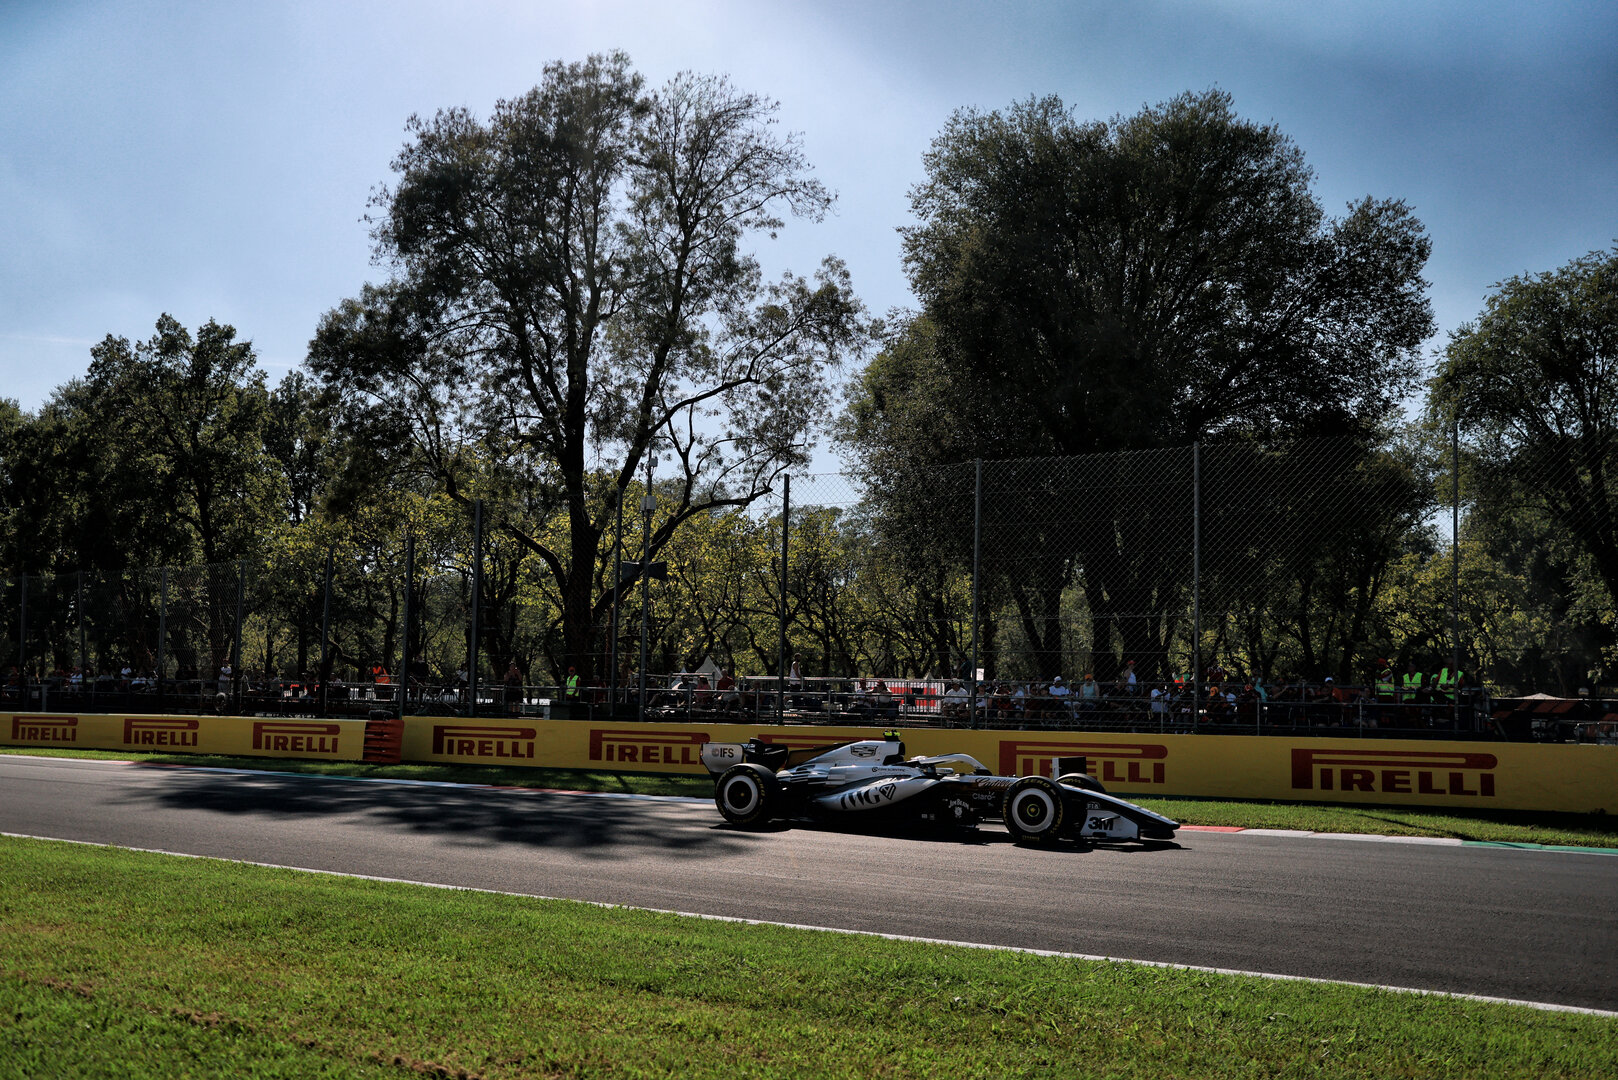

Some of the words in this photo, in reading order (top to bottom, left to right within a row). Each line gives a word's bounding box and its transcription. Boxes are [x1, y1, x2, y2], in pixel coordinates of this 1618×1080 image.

[12, 716, 78, 742] PIRELLI
[123, 718, 199, 747] PIRELLI
[253, 722, 340, 753] PIRELLI
[432, 725, 537, 759] PIRELLI
[589, 729, 710, 765] PIRELL
[720, 748, 734, 758] IFS
[1291, 748, 1498, 797] PIRELLI
[1088, 816, 1114, 831] 3M
